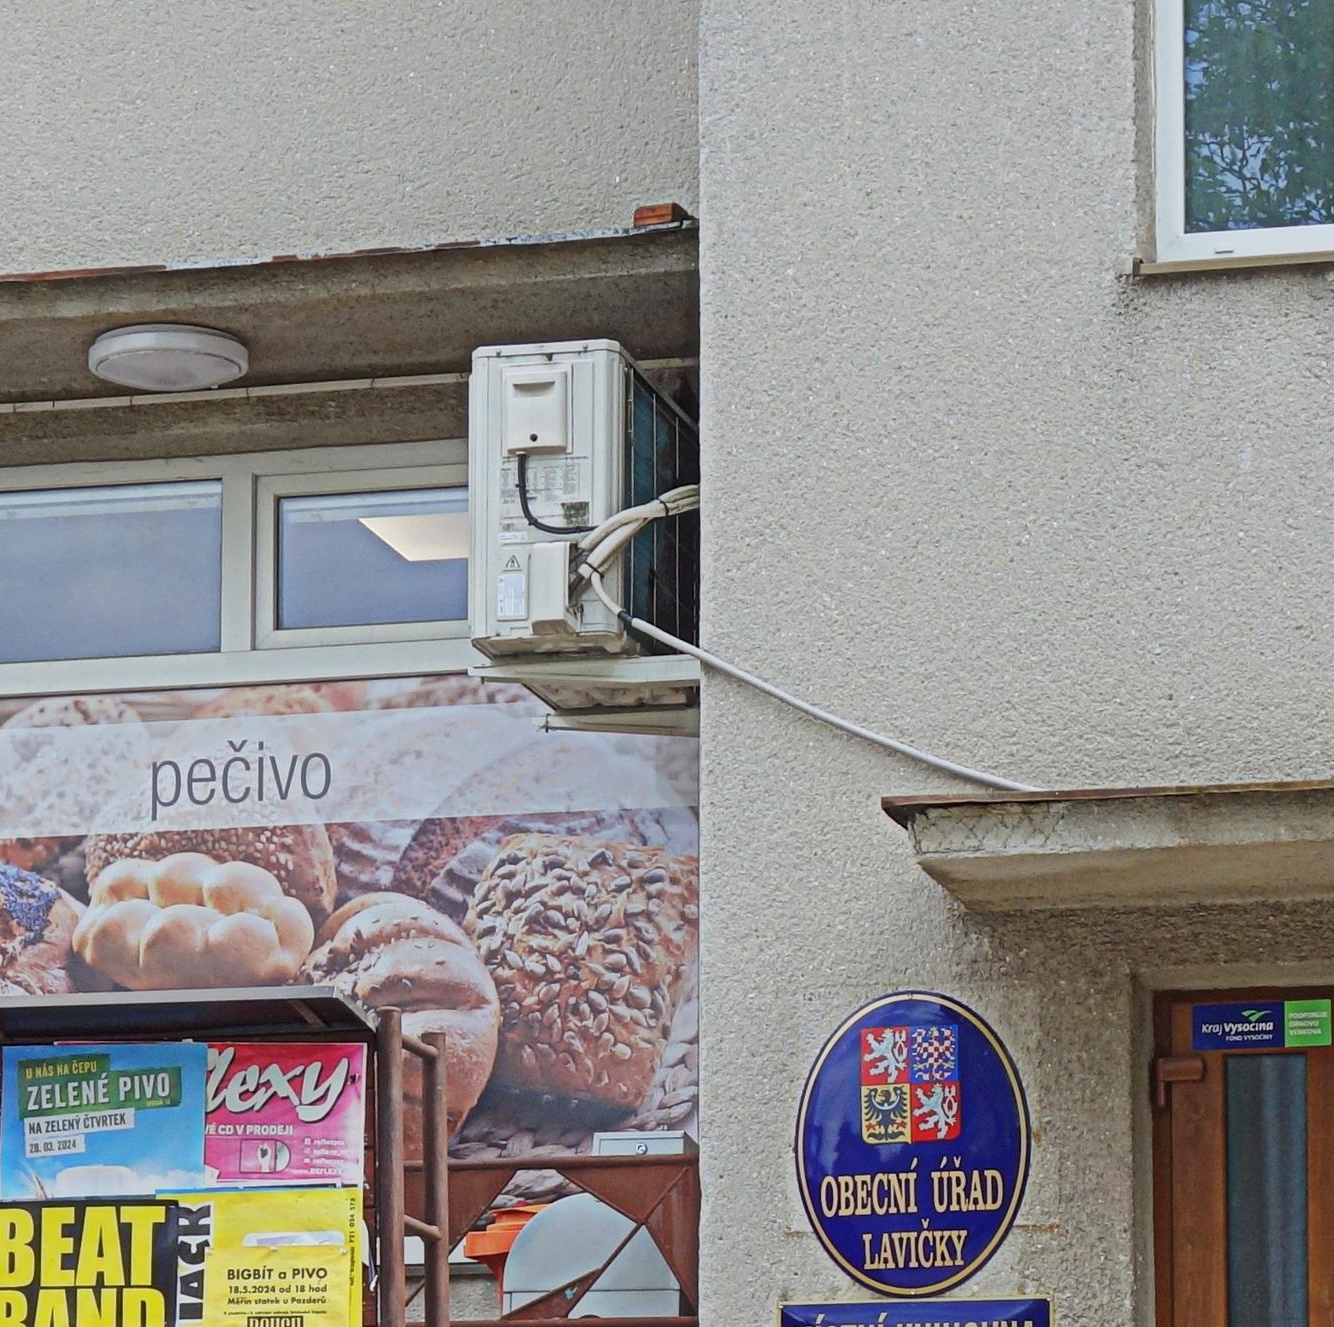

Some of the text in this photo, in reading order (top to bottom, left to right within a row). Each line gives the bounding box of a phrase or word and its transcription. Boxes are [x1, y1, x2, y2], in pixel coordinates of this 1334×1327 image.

[151, 739, 331, 821] pečivo
[1201, 1023, 1223, 1036] Kraj
[25, 1060, 97, 1079] U NÁS NA ČEPU
[27, 1072, 170, 1111] ZELENÉ PIVO
[206, 1047, 349, 1123] lexy
[28, 1112, 126, 1136] NA ZELENÝ ČTVRTEK
[218, 1124, 294, 1136] CD V PRODEJI
[56, 1139, 77, 1151] 2024
[820, 1156, 1004, 1219] OBECNÍ ÚŘAD
[862, 1218, 969, 1271] LAVIČKY
[227, 1265, 328, 1280] BIGBÍT a PIVO
[228, 1284, 327, 1294] 18.5.2024 od 18 hod
[254, 1296, 280, 1305] statek
[291, 1295, 326, 1305] Pazderů
